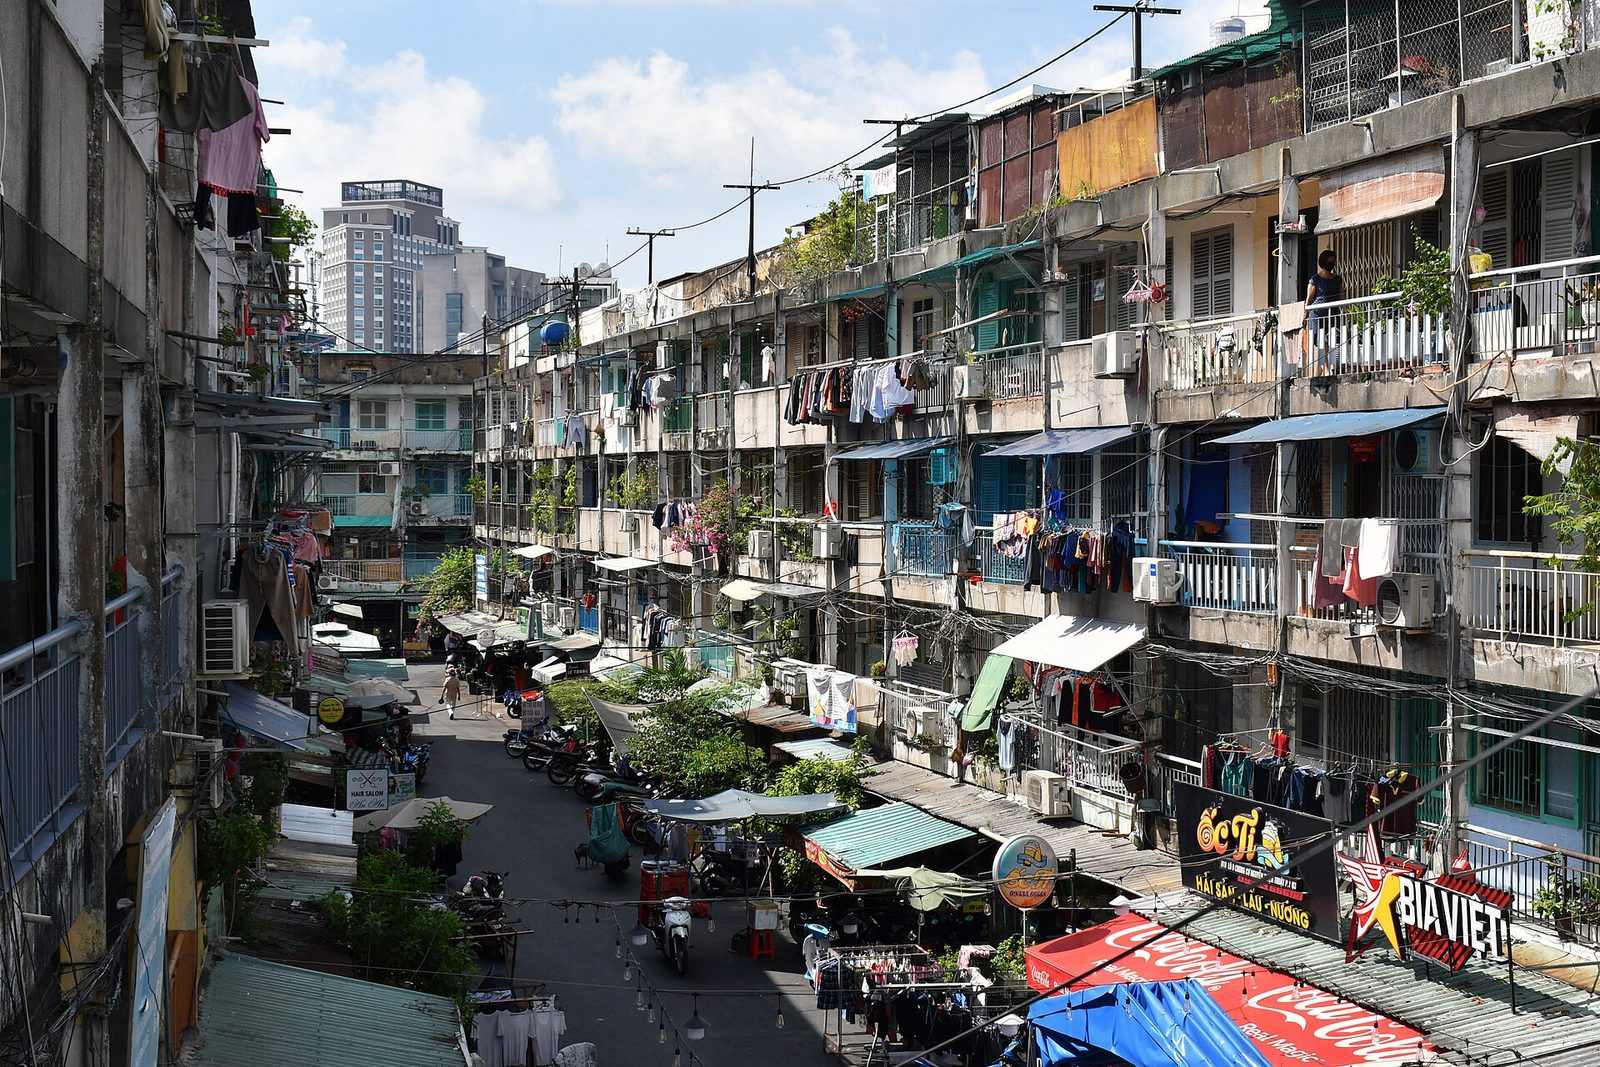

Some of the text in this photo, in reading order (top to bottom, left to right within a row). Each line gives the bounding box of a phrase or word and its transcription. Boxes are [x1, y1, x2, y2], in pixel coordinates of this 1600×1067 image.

[1196, 871, 1214, 895] HẢI
[1399, 875, 1503, 959] BIA VIỆT
[1239, 1023, 1319, 1063] Real Magic
